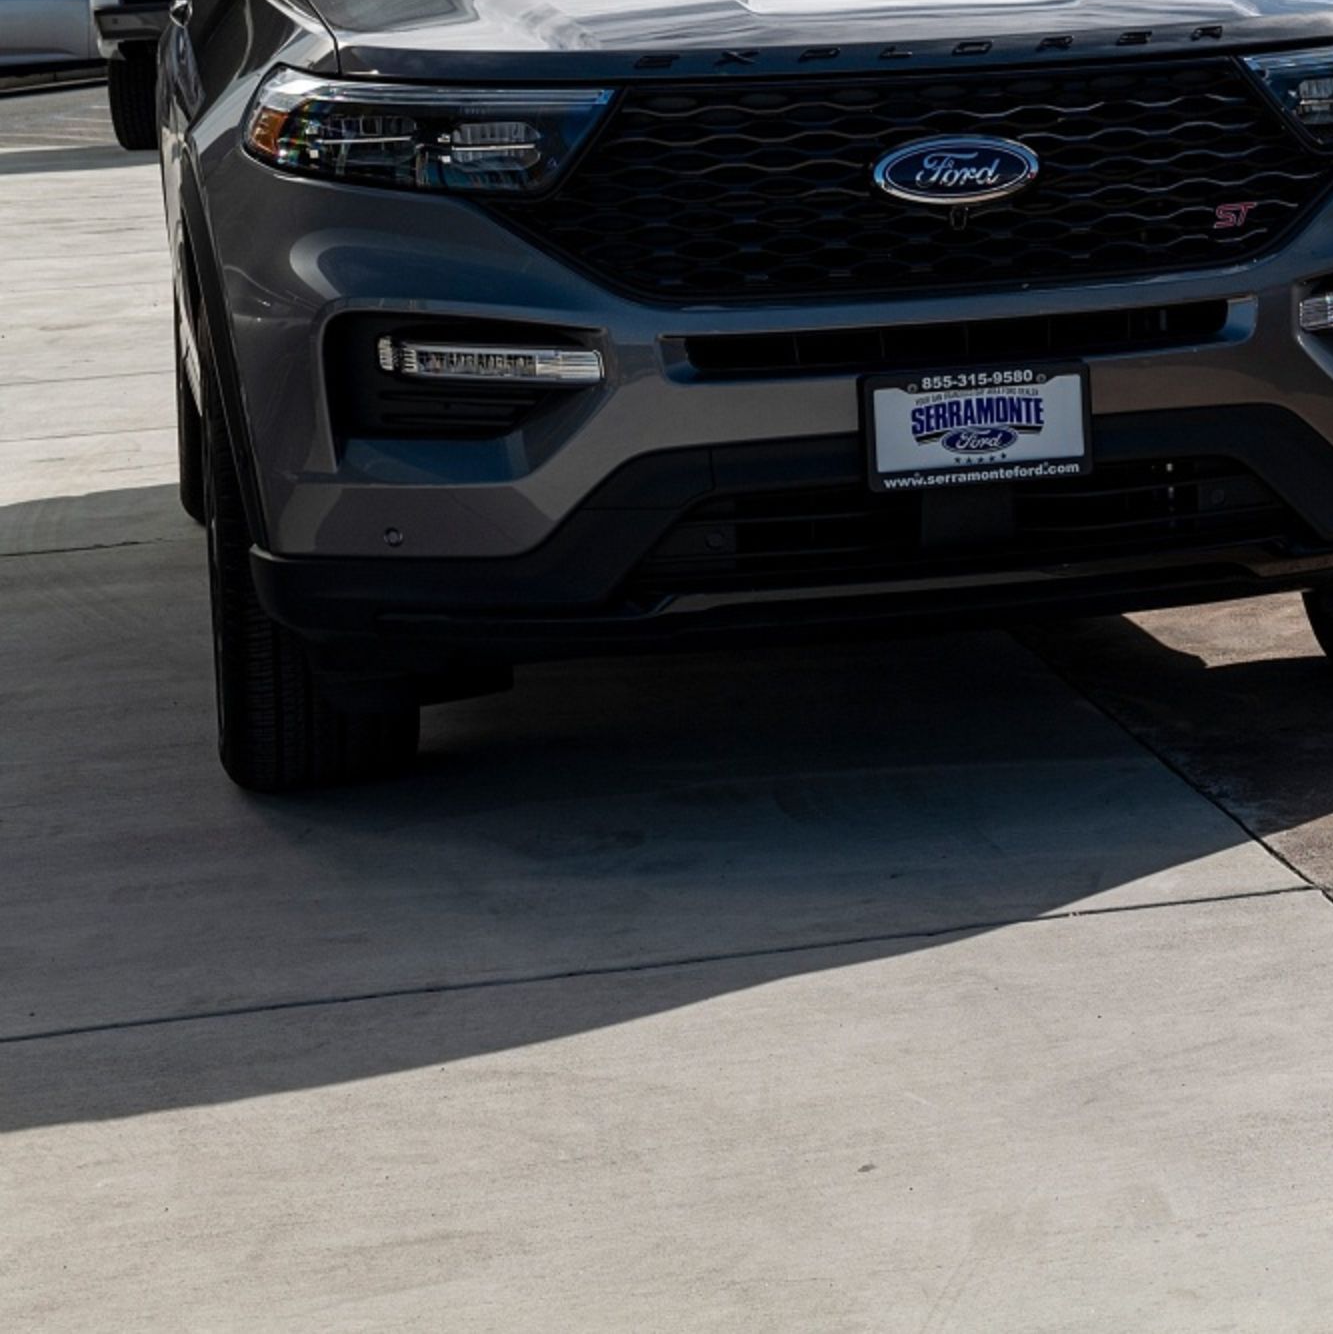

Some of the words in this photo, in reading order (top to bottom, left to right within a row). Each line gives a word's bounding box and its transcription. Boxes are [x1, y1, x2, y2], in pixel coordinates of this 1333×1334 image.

[635, 26, 1224, 68] EXPLORER
[915, 153, 1001, 187] Ford
[1213, 201, 1258, 229] ST
[921, 369, 1034, 391] 855-315-9580
[911, 396, 1044, 436] SERRAMONTE
[954, 429, 1003, 450] Ford
[883, 462, 1080, 490] www.serramonteford.com
